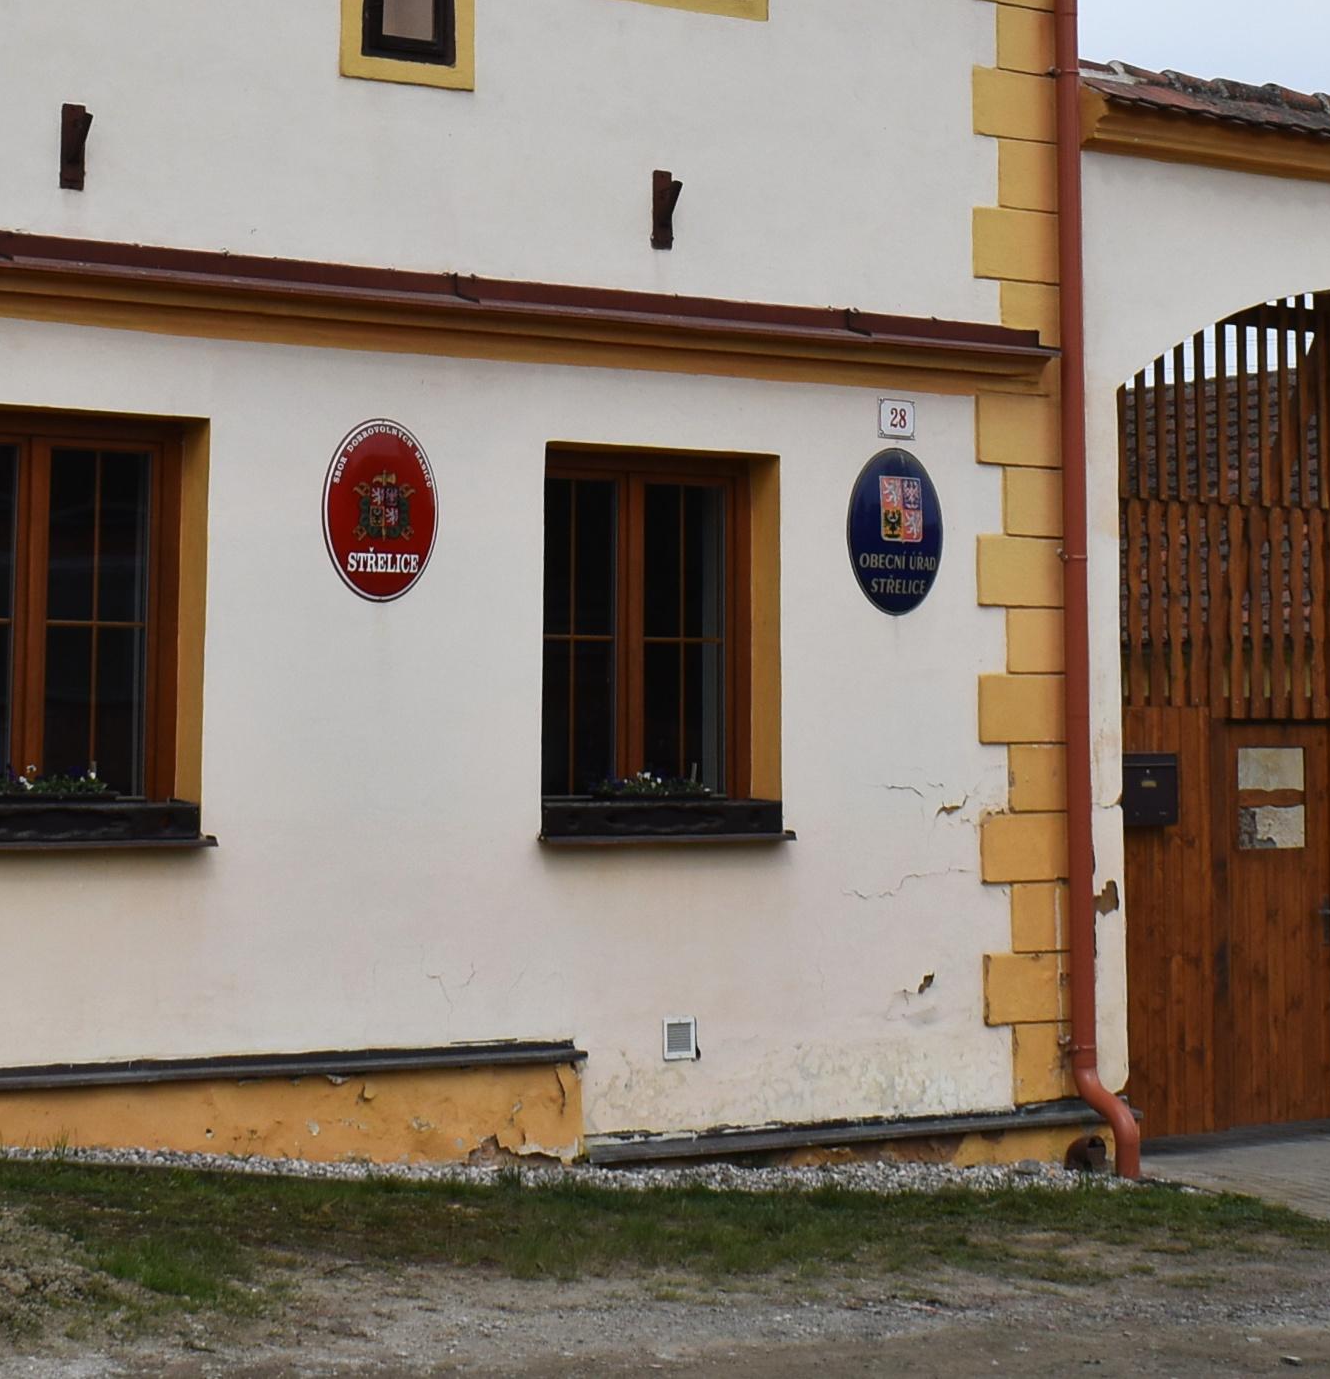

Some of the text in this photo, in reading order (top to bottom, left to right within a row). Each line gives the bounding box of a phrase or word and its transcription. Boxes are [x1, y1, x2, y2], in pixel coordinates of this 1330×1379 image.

[889, 407, 907, 429] 28
[332, 456, 348, 484] SBOR
[347, 546, 420, 573] STŘELICE
[859, 550, 937, 571] OBECNÍ ÚŘAD
[870, 575, 927, 595] STŘELICE
